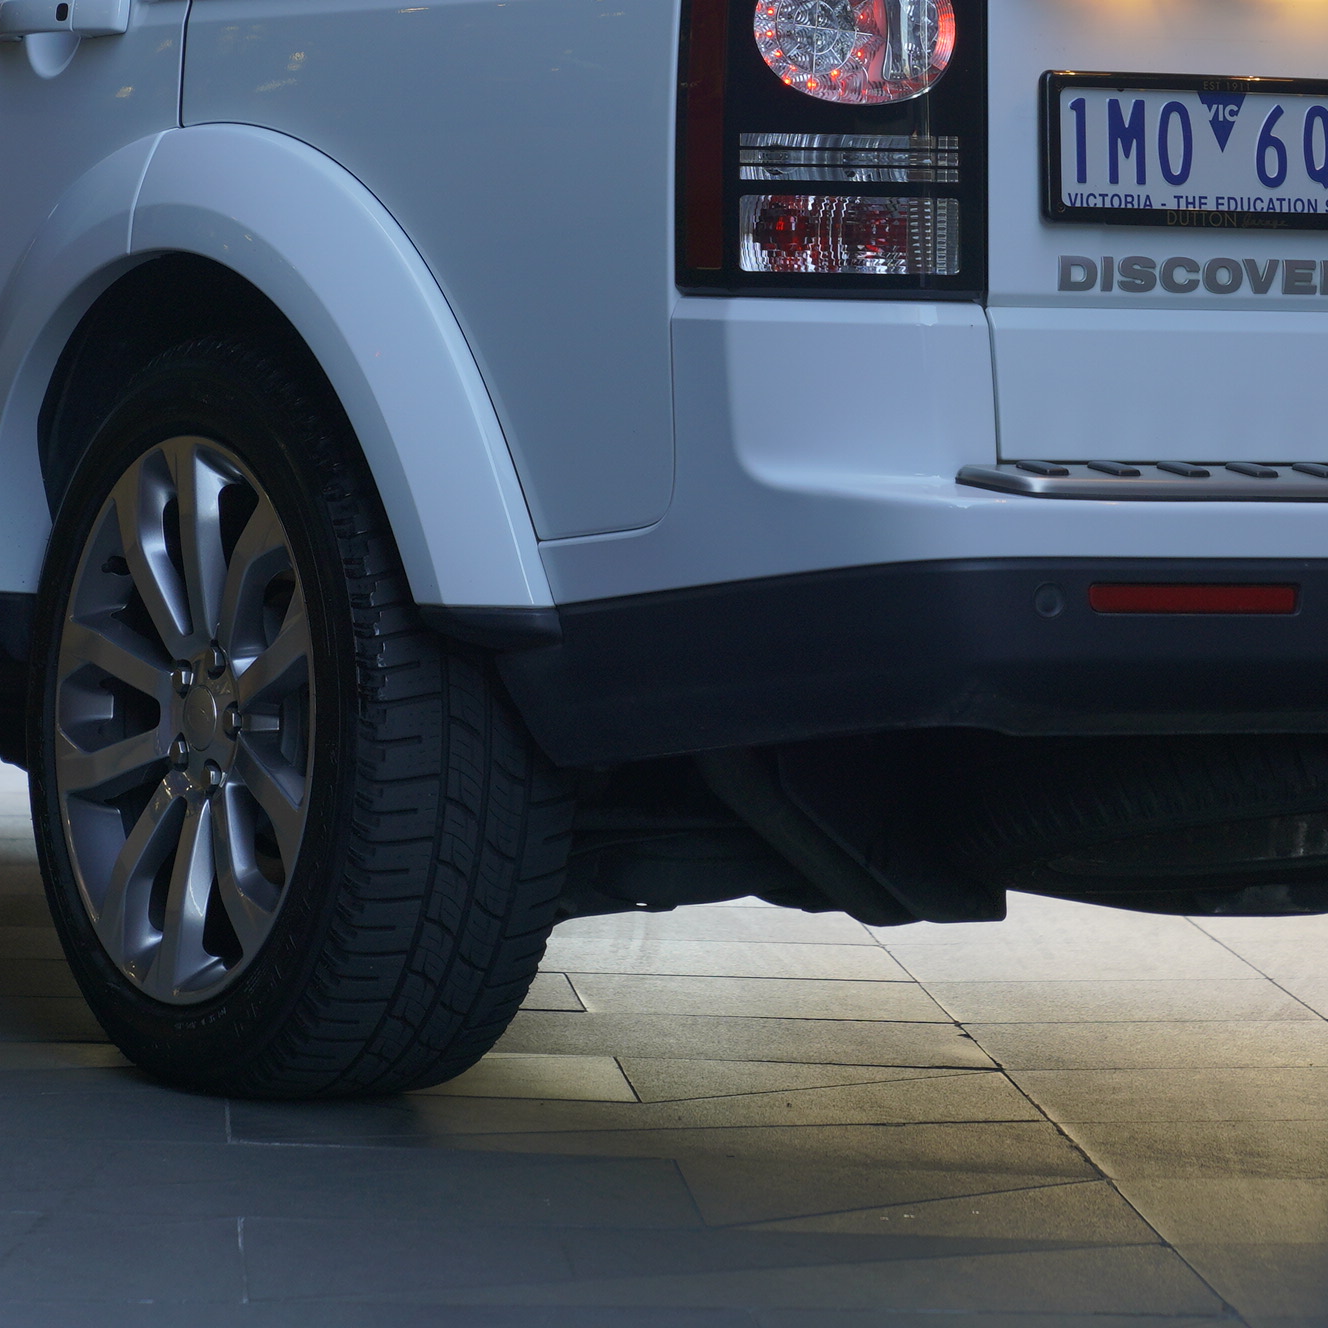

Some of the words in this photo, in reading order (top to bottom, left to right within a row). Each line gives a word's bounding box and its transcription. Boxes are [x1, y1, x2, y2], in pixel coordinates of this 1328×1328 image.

[1203, 81, 1221, 91] EST
[1202, 104, 1239, 122] VIC
[1067, 192, 1153, 209] VICTORIA
[1173, 195, 1208, 210] THE
[1215, 196, 1318, 213] EDUCATION
[1166, 210, 1237, 228] DUTTON
